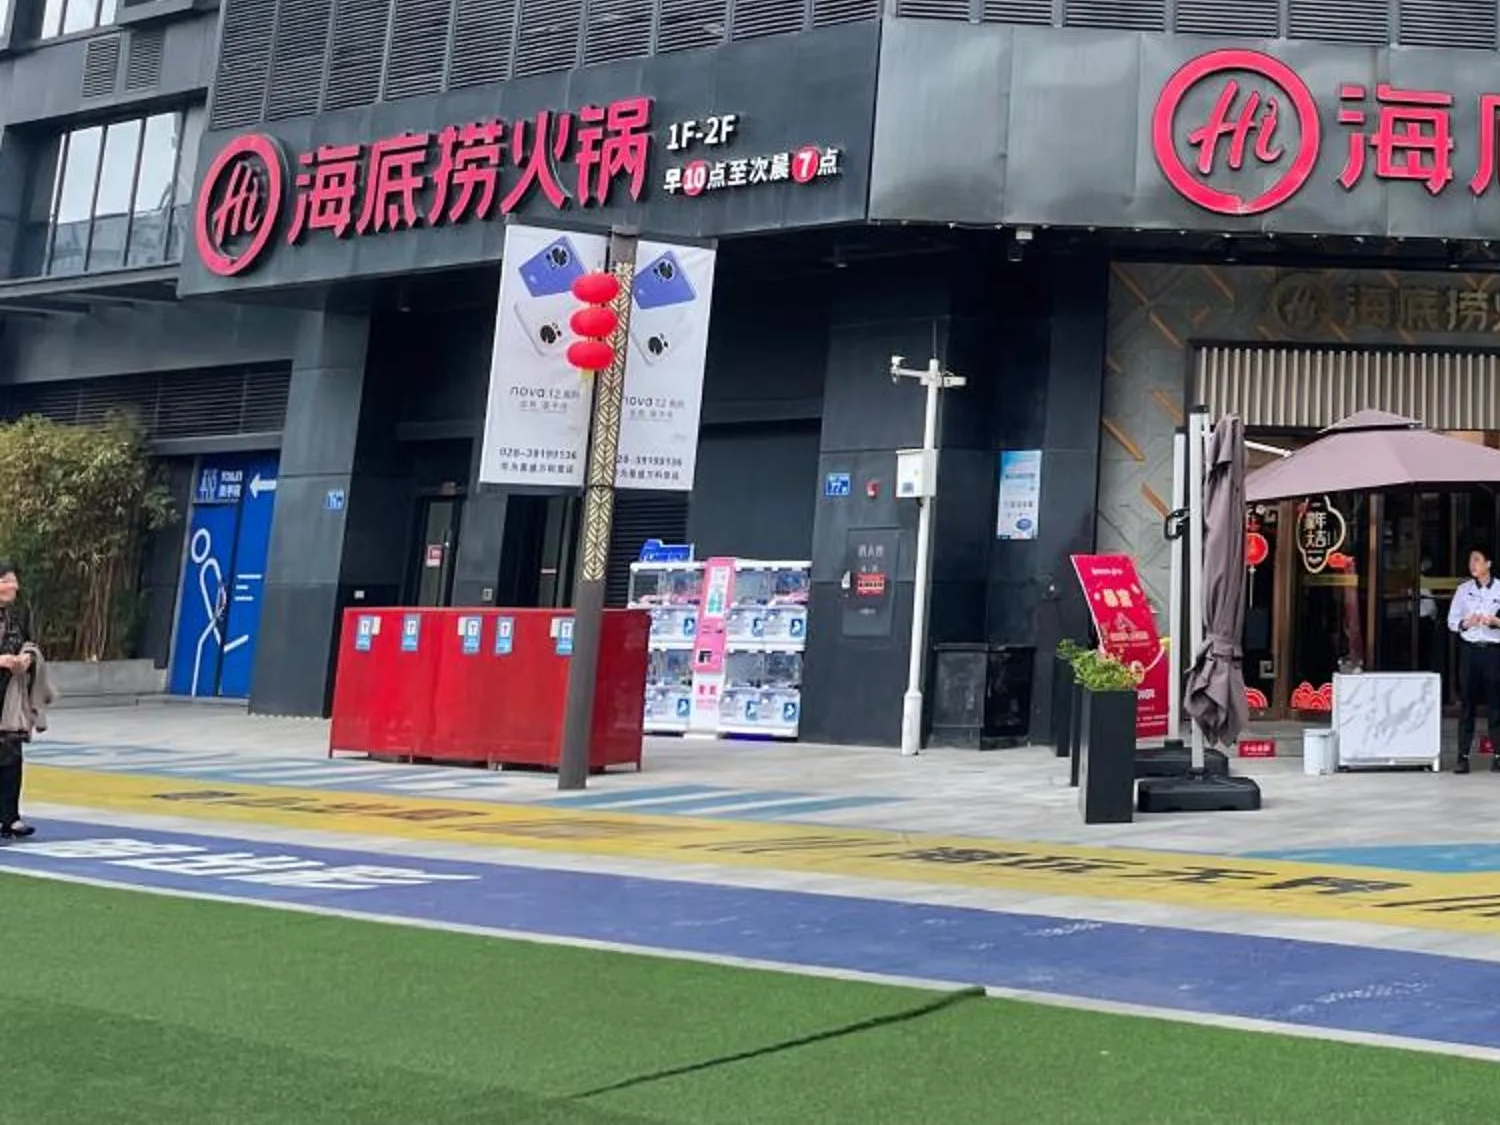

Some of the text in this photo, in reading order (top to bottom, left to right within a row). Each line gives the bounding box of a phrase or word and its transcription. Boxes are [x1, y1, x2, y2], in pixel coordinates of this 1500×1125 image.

[286, 97, 656, 246] 海底捞火锅
[667, 115, 736, 150] 1F-2F
